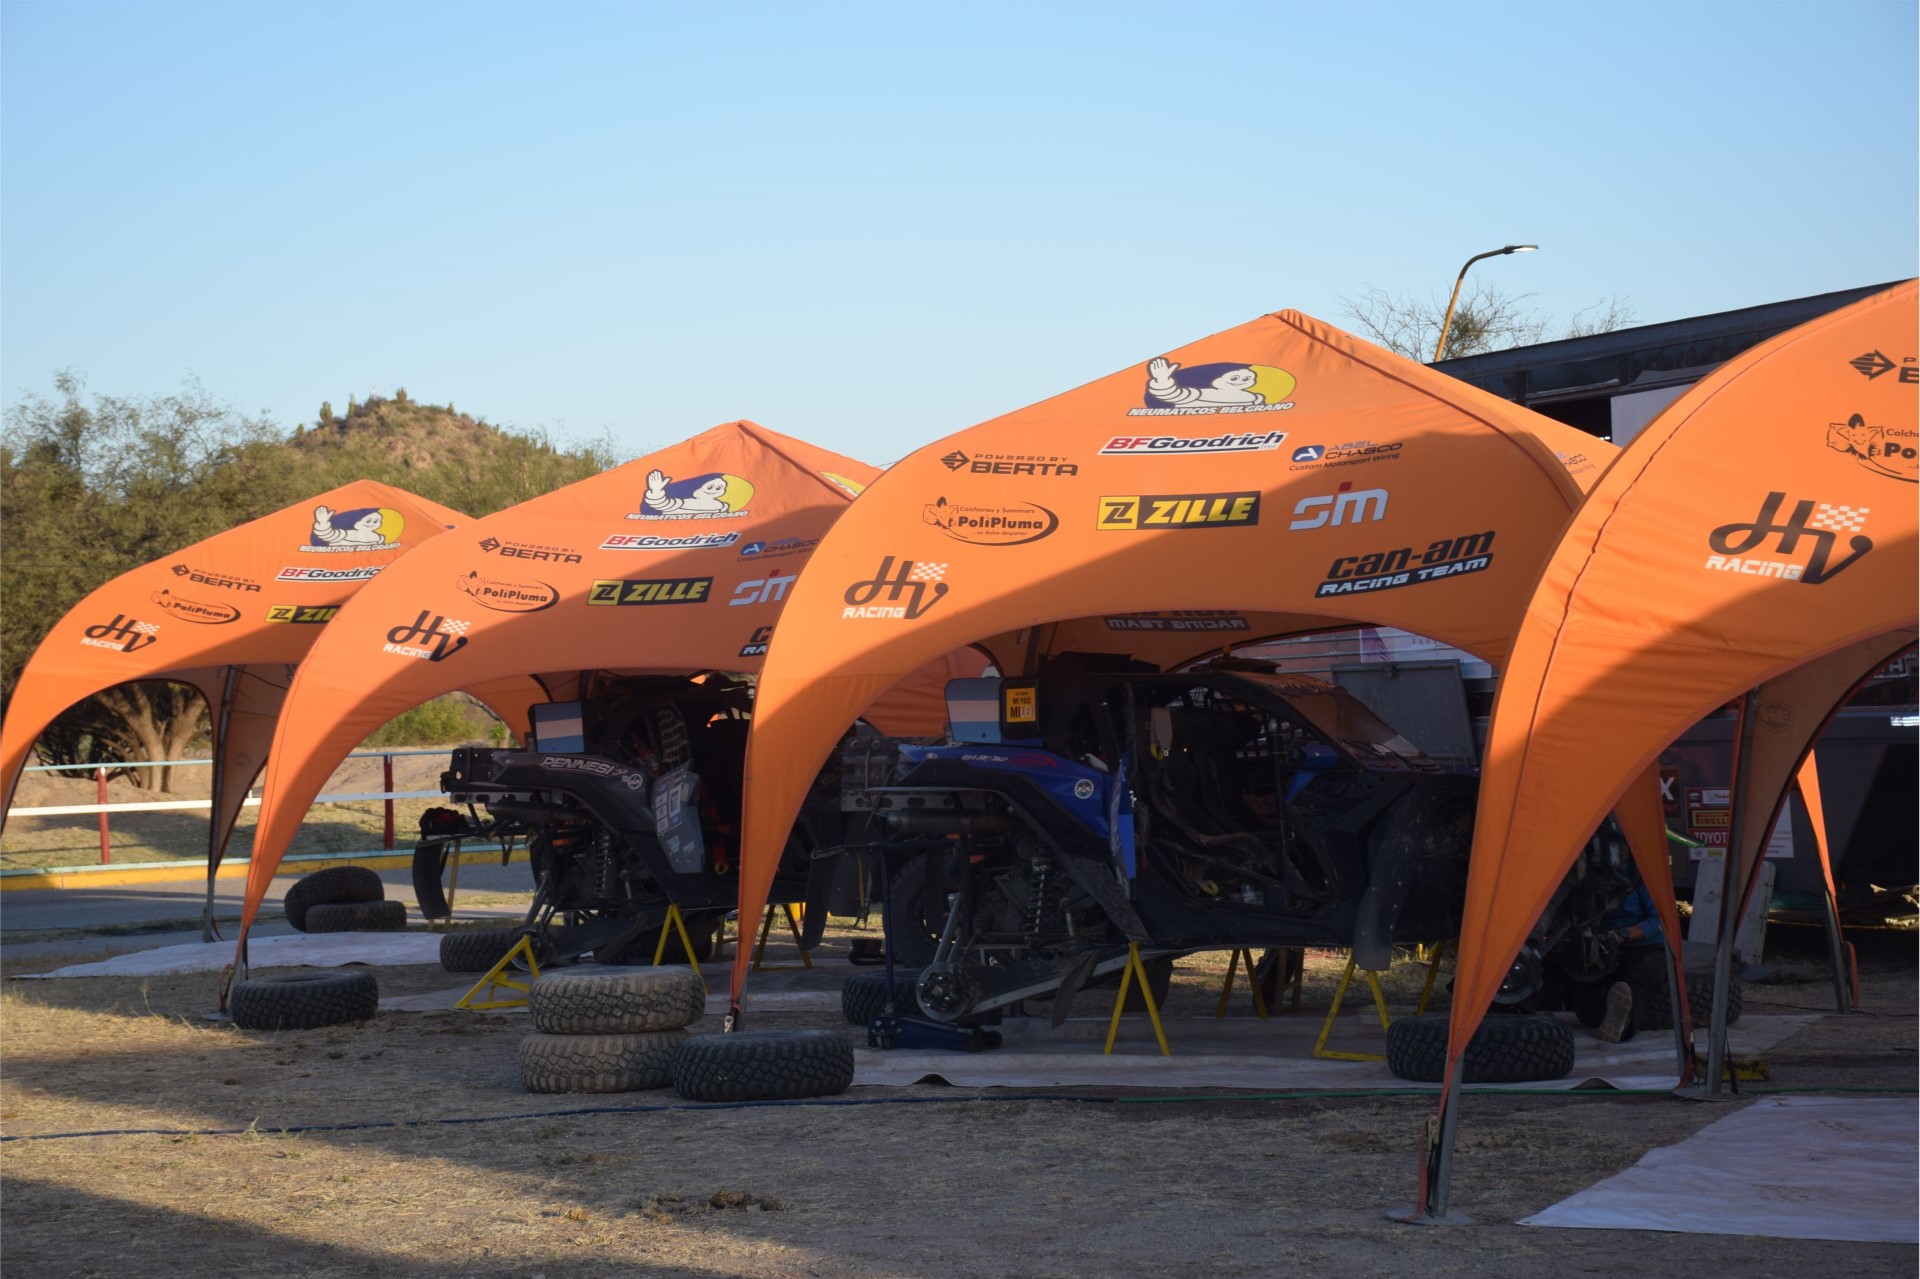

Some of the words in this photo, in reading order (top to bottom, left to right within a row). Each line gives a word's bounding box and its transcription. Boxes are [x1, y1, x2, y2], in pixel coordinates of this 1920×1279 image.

[1127, 406, 1216, 417] NEUMATICOS
[1219, 402, 1295, 414] BELGRANO
[1106, 432, 1284, 450] BFGoodrich
[974, 453, 1045, 461] POWERED
[1325, 443, 1402, 460] CHASCO
[970, 461, 1079, 476] BERTA
[1289, 464, 1322, 472] Custom
[1324, 458, 1370, 468] Motorsport
[1373, 453, 1400, 462] Wiring
[625, 512, 692, 521] NEUMATICOS
[694, 510, 749, 520] BELGRANO
[1144, 497, 1256, 524] ZILLE
[958, 516, 1044, 529] PoliPluma
[505, 541, 559, 552] POWERED
[606, 533, 739, 546] BFGoodrich
[499, 547, 582, 564] BERTA
[1327, 530, 1496, 579] can-am
[280, 565, 384, 578] BFGoodric
[1320, 573, 1409, 595] RACING
[1418, 557, 1488, 580] TEAM
[1705, 555, 1804, 582] RACING
[189, 574, 262, 593] BERTA
[624, 581, 709, 601] ZILLE
[483, 587, 548, 602] PoliPluma
[174, 602, 230, 619] PoliPluma
[842, 607, 905, 619] RACING
[80, 637, 125, 651] RACING
[383, 644, 432, 660] RACING
[1695, 832, 1728, 844] TOYOT
